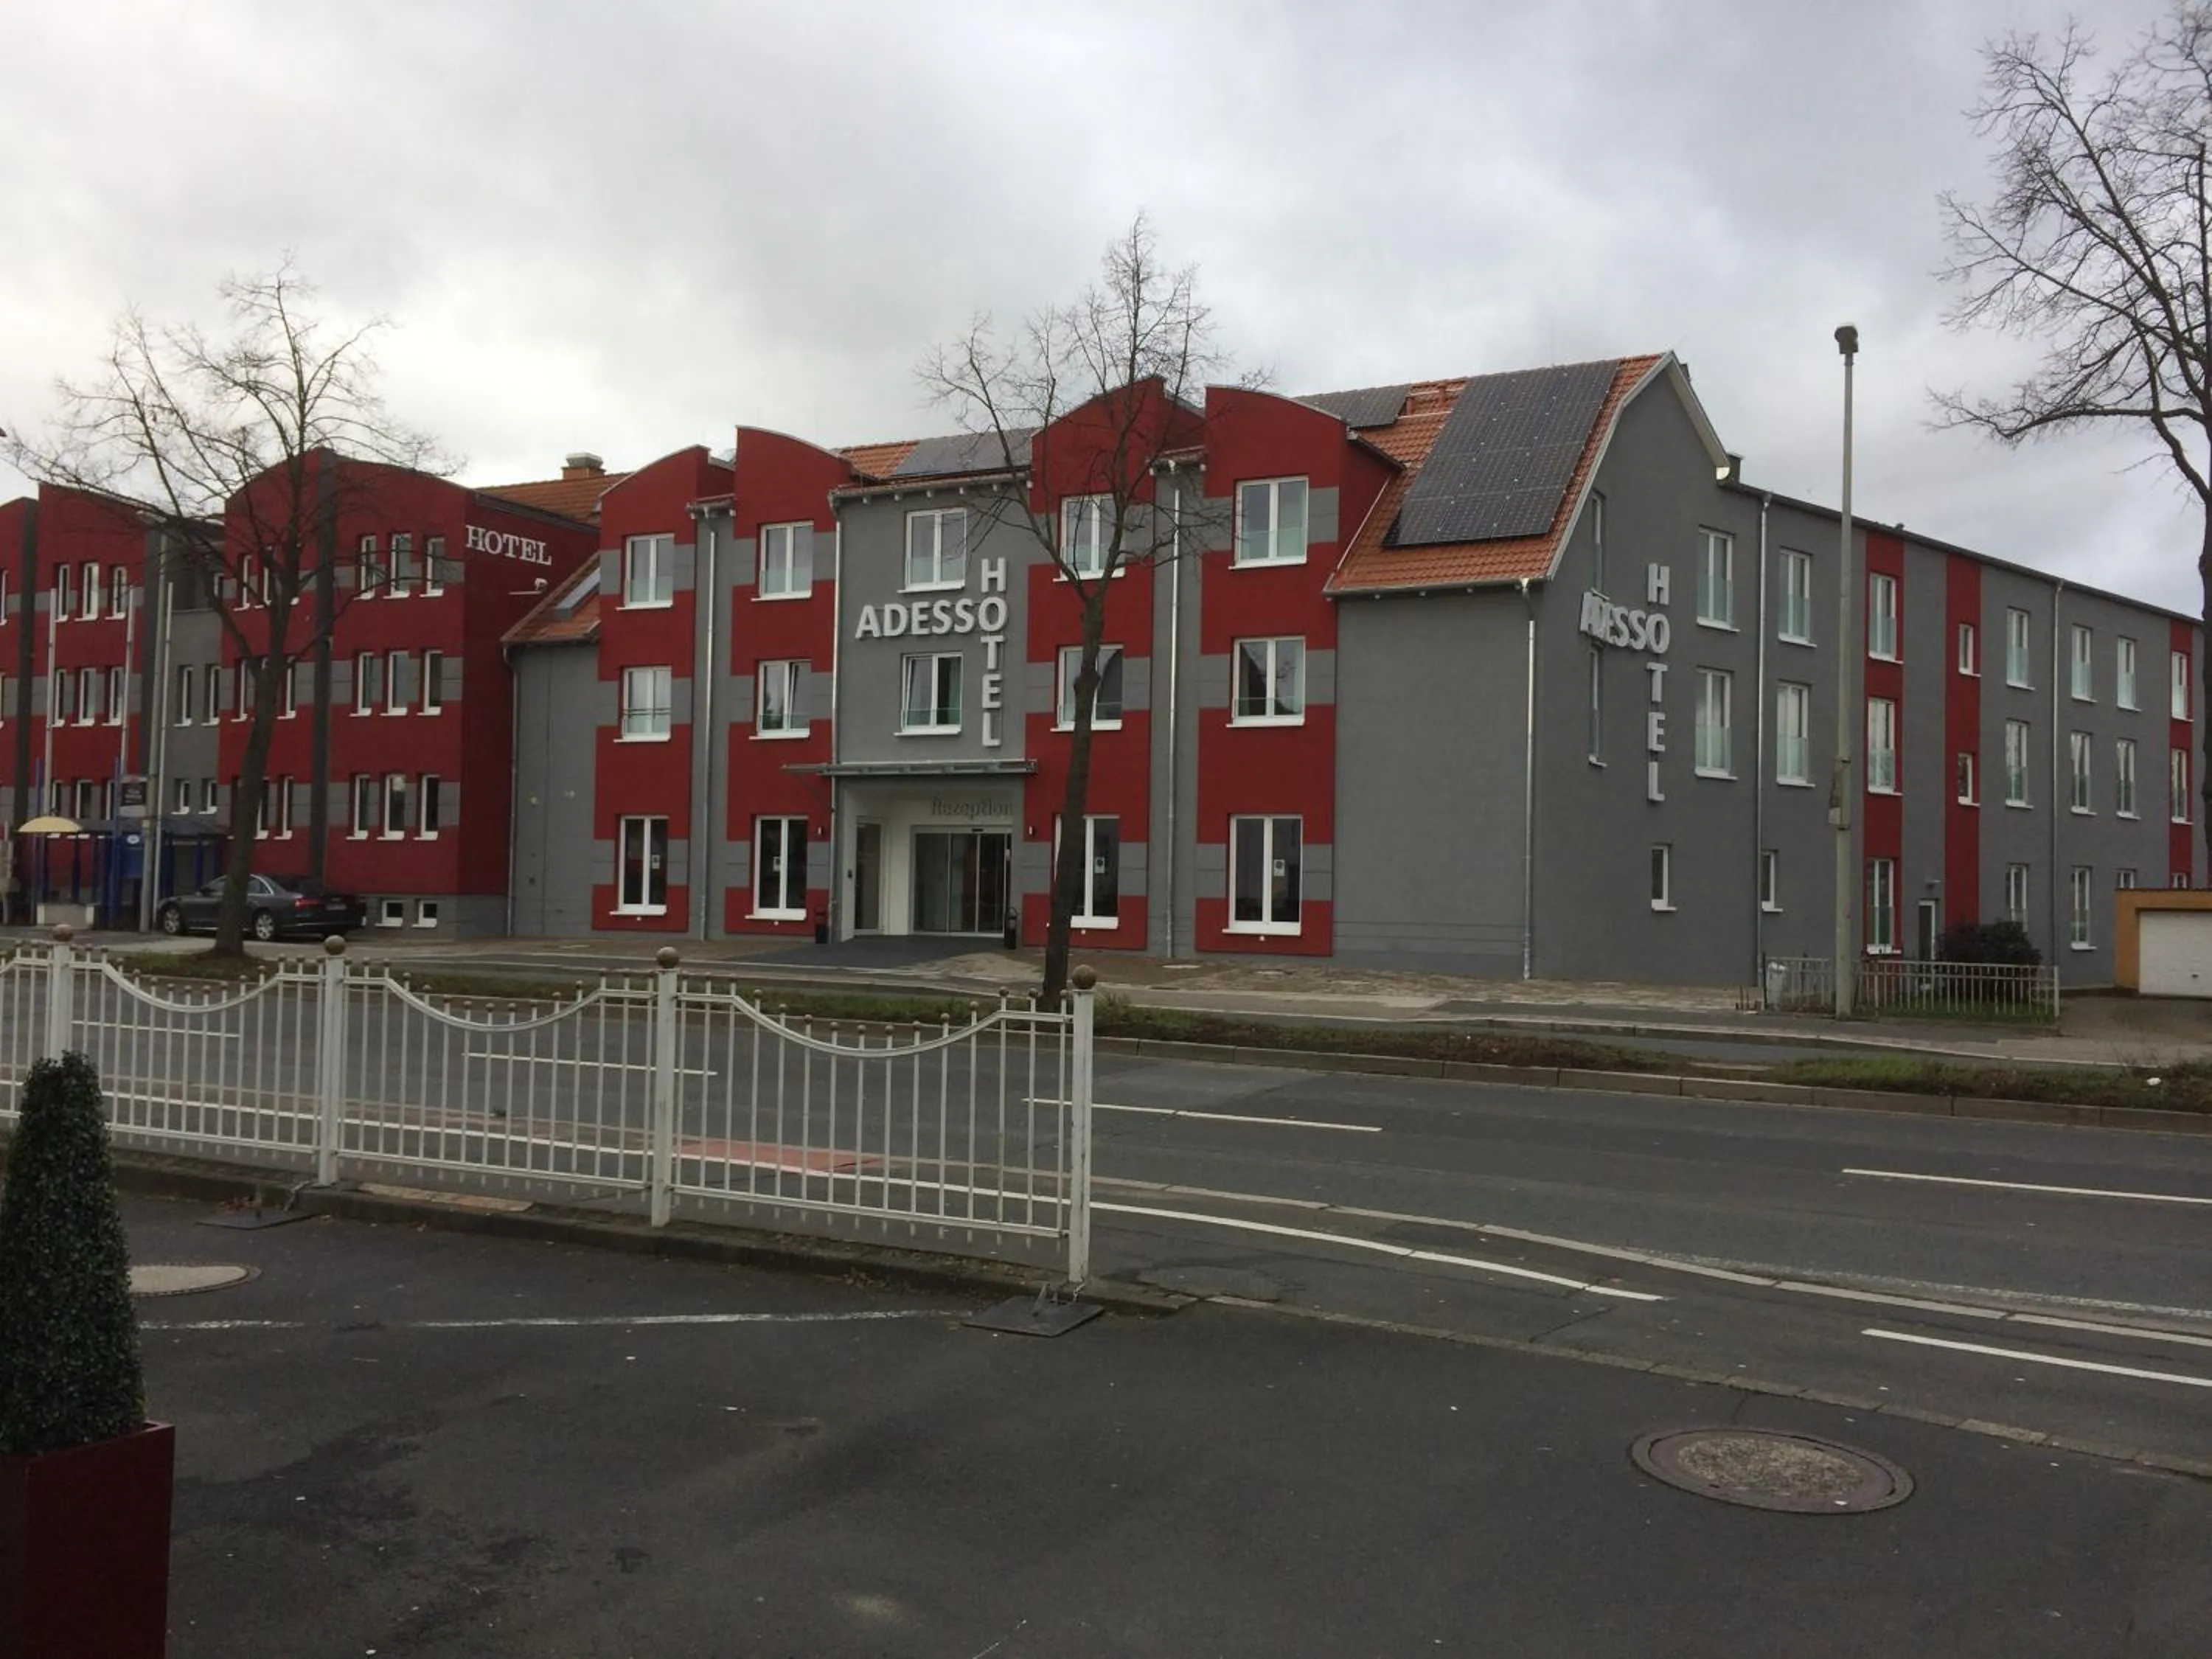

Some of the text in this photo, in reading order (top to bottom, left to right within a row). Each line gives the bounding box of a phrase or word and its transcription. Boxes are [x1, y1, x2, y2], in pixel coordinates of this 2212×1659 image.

[465, 525, 552, 566] HOTEL
[855, 597, 1008, 639] ADESSO
[978, 557, 1008, 747] HOTEL
[1645, 563, 1671, 801] HOTEL
